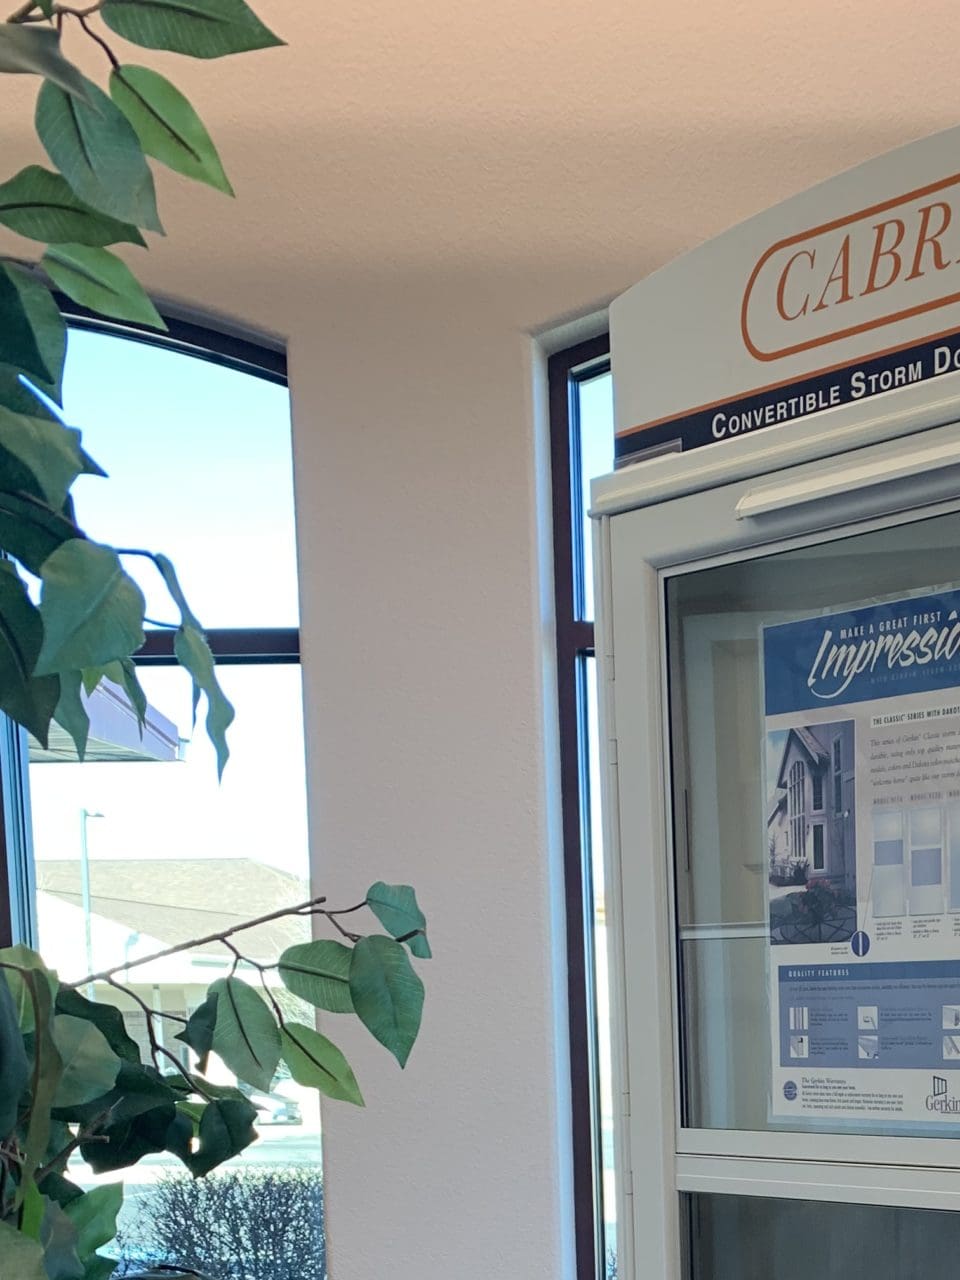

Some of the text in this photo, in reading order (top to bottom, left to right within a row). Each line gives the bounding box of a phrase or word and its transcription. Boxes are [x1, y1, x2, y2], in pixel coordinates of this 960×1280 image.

[712, 385, 841, 439] CONVERTIBLE
[850, 360, 923, 398] STORM
[840, 611, 941, 639] MAKE A GREAT FIRST
[873, 717, 882, 725] THE
[907, 712, 925, 720] SERIES
[927, 709, 940, 717] WITH
